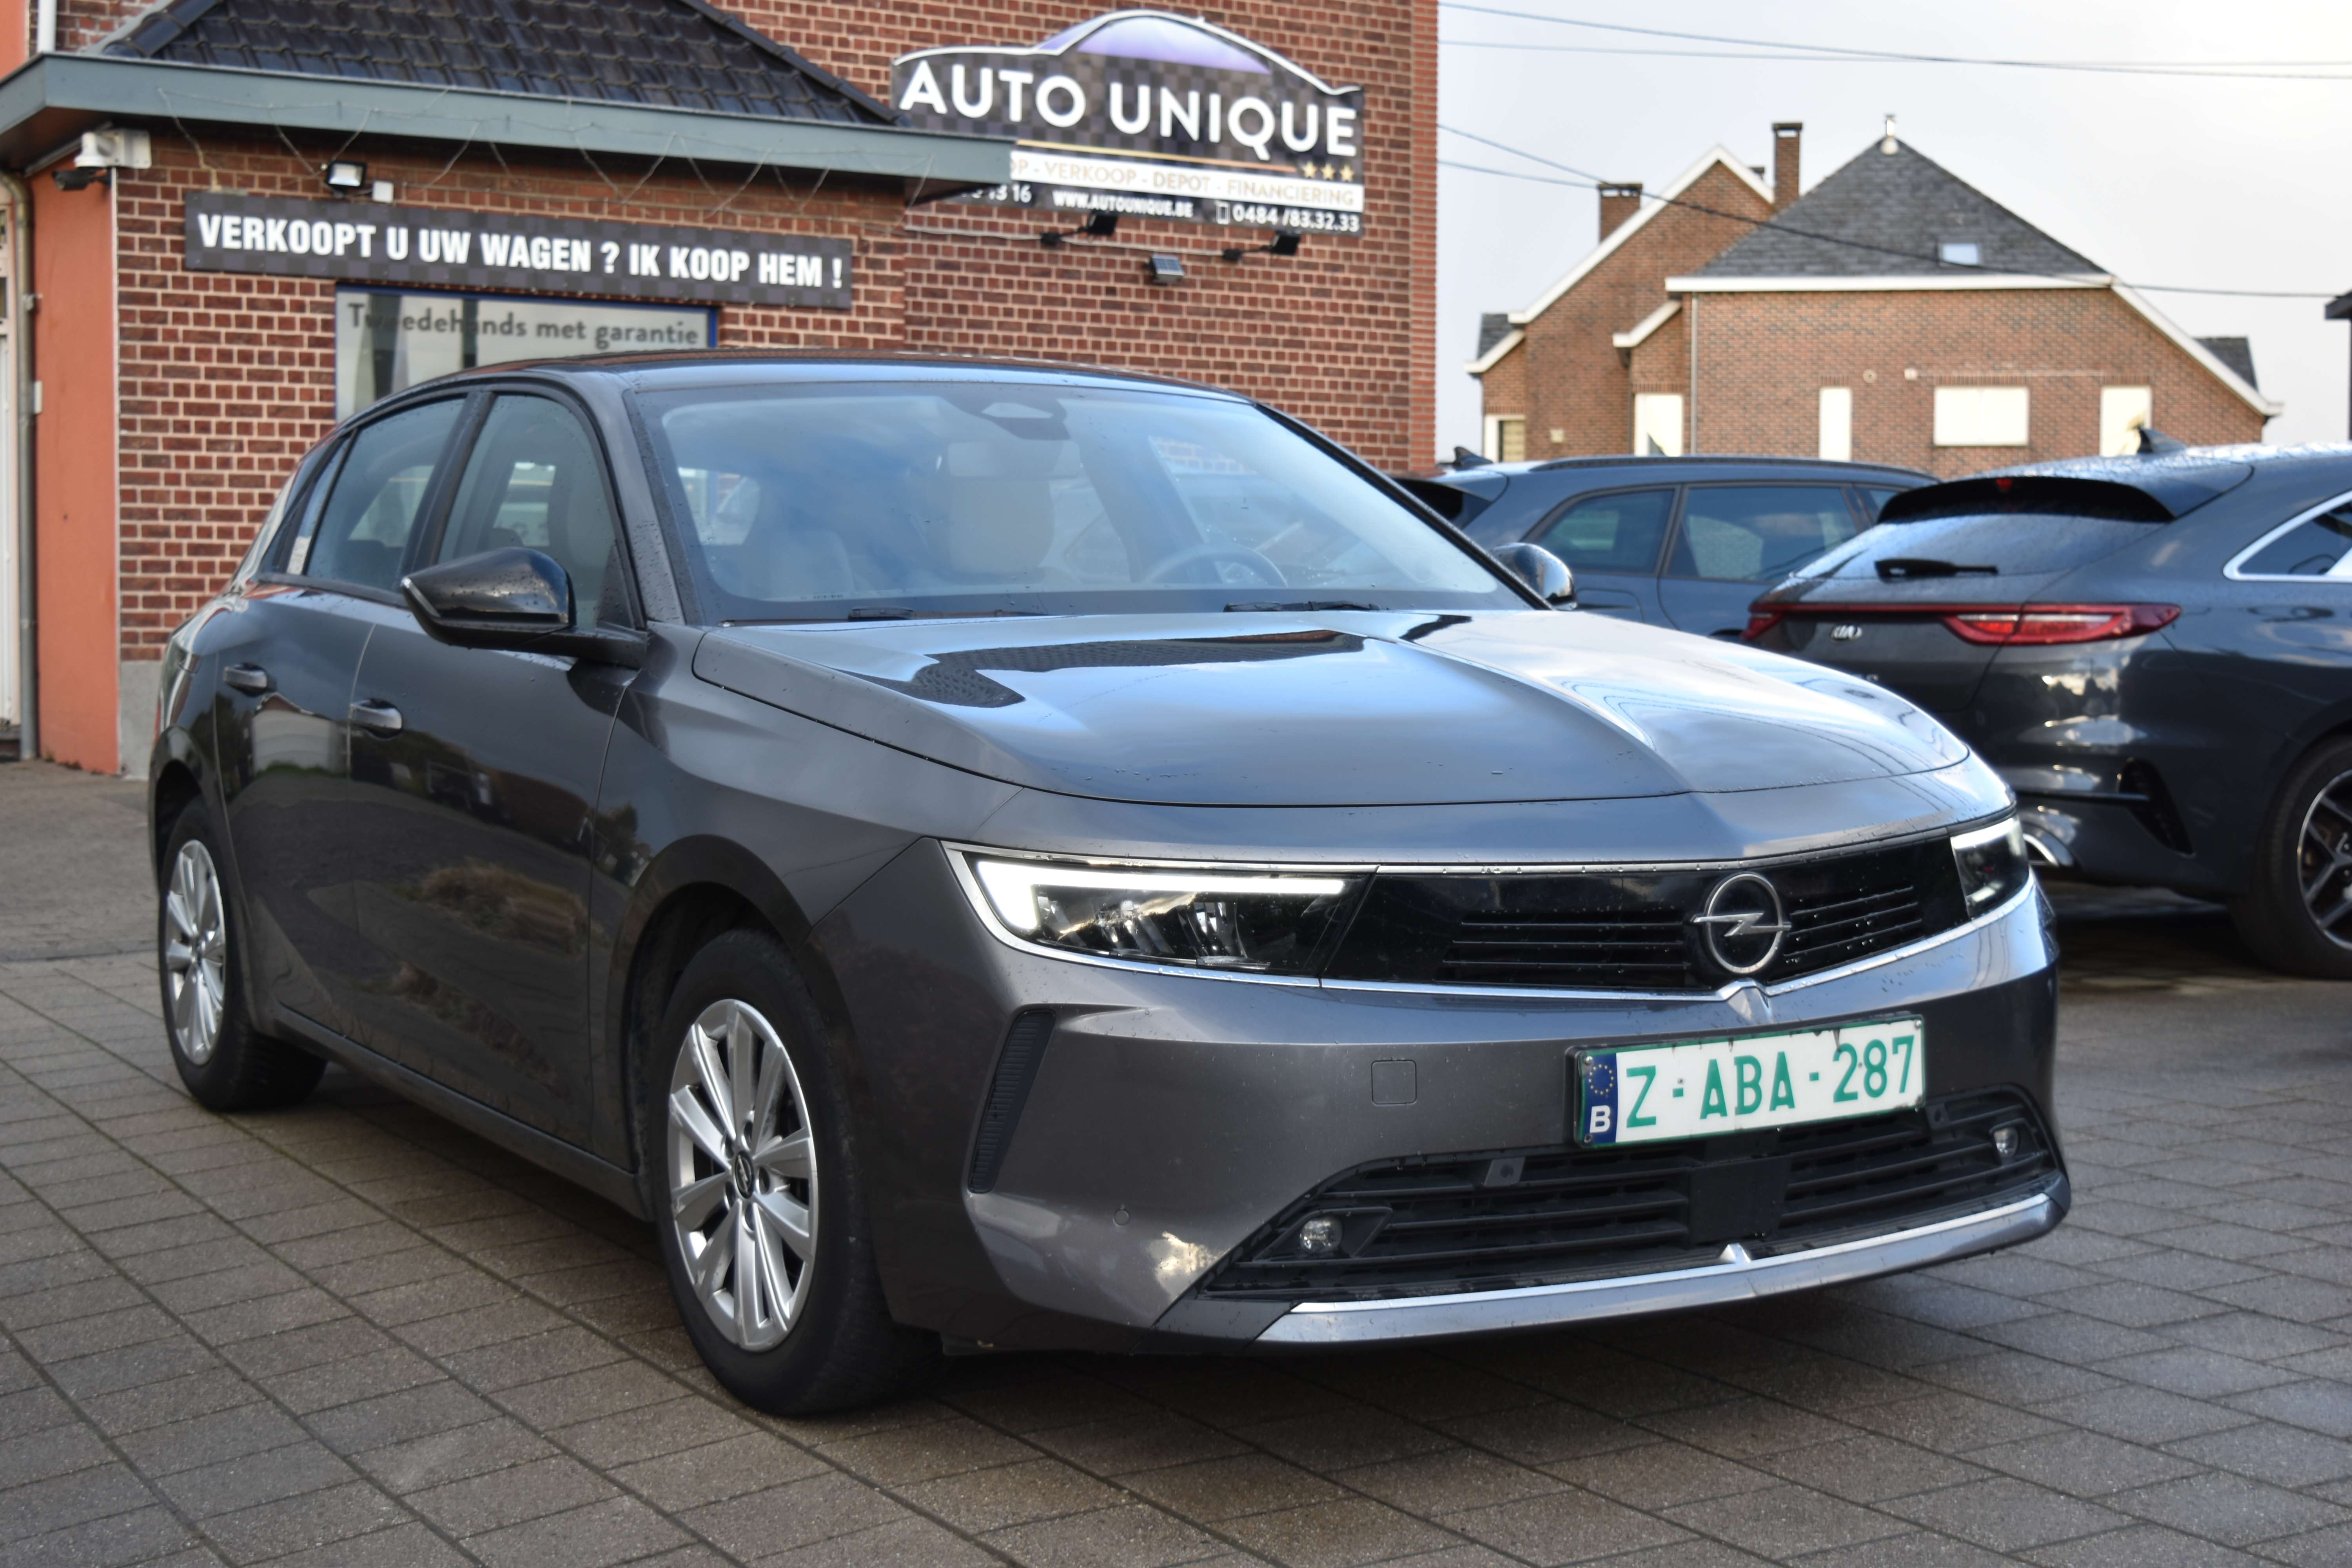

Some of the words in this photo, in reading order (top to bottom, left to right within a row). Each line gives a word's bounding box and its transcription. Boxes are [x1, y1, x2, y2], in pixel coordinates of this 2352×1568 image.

[899, 60, 1086, 127] AUTO
[1110, 82, 1356, 160] UNIQUE
[1012, 183, 1032, 203] 16
[1045, 162, 1136, 185] VERKOOP
[1153, 172, 1210, 191] DEPOT
[1228, 179, 1354, 206] FINANCIERING
[1052, 190, 1194, 218] WWW.AUTOUNIQUE.BE
[1232, 203, 1278, 225] 0484
[198, 213, 376, 257] VERKOOPT
[386, 227, 408, 260] U
[418, 228, 471, 264] UW
[481, 233, 591, 272] WAGEN
[601, 241, 620, 274] ?
[629, 244, 661, 277] IK
[669, 247, 750, 281] KOOP
[759, 252, 822, 287] HEM
[832, 257, 842, 288] !
[536, 321, 586, 339] met
[595, 321, 699, 350] garantie
[1589, 1105, 1611, 1134] B
